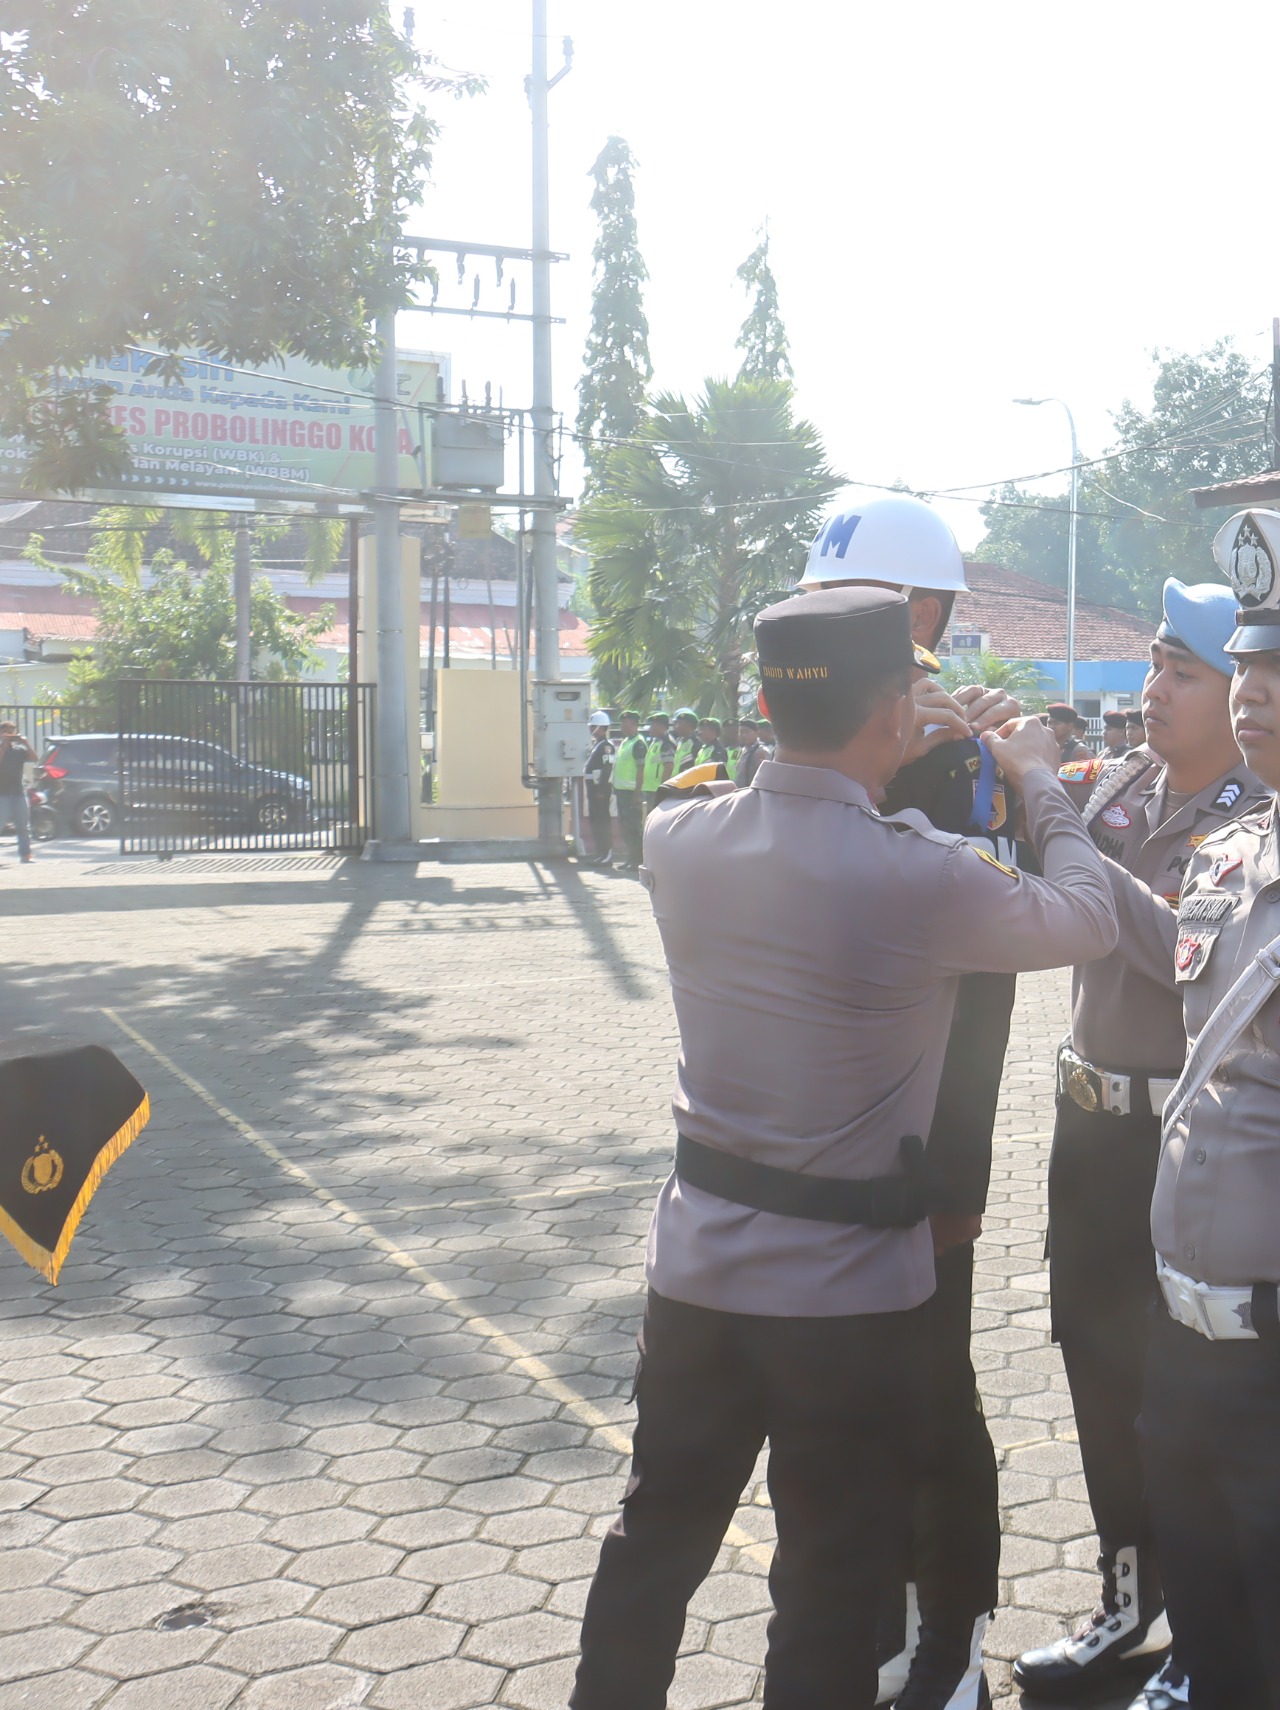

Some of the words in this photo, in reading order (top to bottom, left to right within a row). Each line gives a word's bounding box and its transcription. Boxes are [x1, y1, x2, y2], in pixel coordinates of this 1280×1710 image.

[130, 379, 194, 402] Anda
[200, 385, 288, 410] Kepada
[293, 393, 351, 415] Kami
[154, 408, 342, 451] PROBOLINGGO
[349, 424, 413, 456] KOA
[143, 442, 208, 460] Korupsi
[213, 447, 266, 465] (WBK)
[270, 452, 282, 464] &
[162, 460, 239, 478] Melayani
[245, 464, 311, 482] (WBBM)
[786, 667, 828, 680] WAHYU
